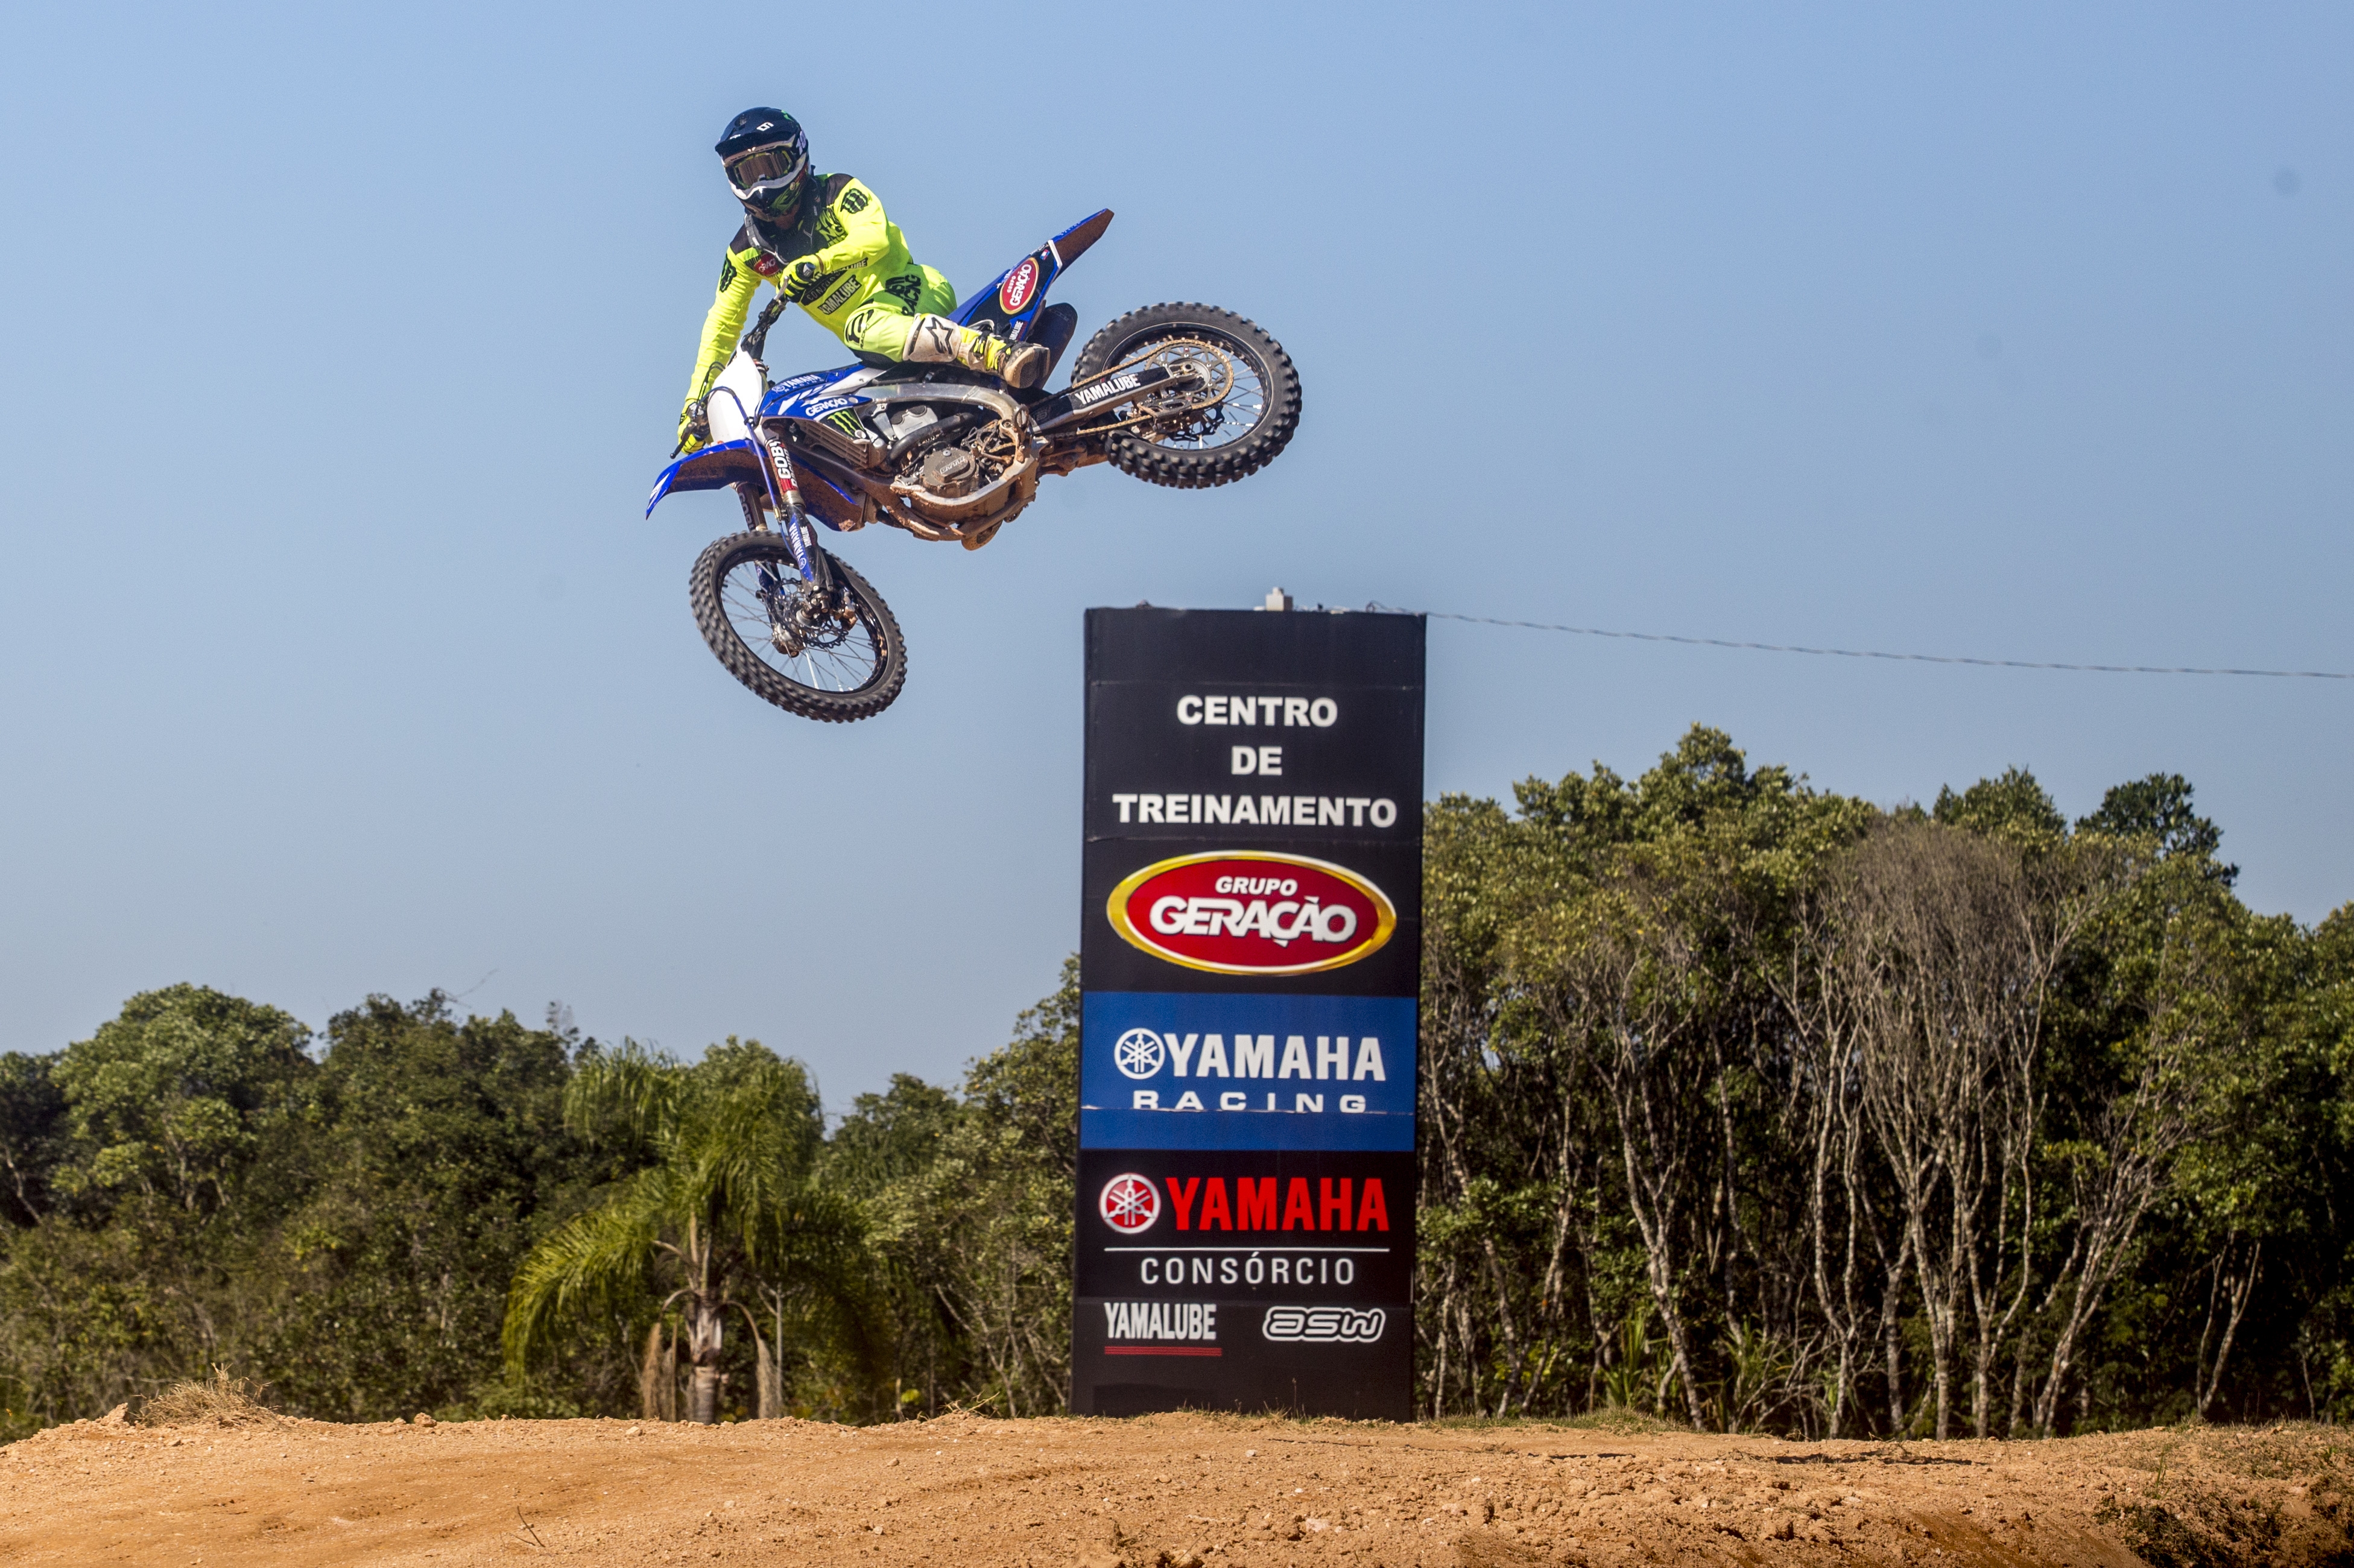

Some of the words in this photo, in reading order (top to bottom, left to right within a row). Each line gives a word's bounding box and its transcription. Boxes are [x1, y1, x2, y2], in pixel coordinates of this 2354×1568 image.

[1007, 276, 1016, 293] GRUPO
[1009, 264, 1032, 306] GERAÇÃO
[782, 375, 821, 388] YAMAHA
[1075, 373, 1141, 405] YAMALUBE
[789, 522, 805, 561] YAMAHA
[1176, 695, 1338, 727] CENTRO
[1231, 746, 1282, 775] DE
[1112, 794, 1397, 827] TREINAMENTO
[1215, 876, 1298, 896] GRUPO
[1149, 896, 1358, 947] GERAÇÃO
[1163, 1033, 1386, 1081] YAMAHA
[1133, 1090, 1366, 1113] RACING
[1165, 1177, 1389, 1231] YAMAHA
[1141, 1252, 1355, 1285] CONSÓRCIO
[1104, 1302, 1217, 1340] YAMALUBE
